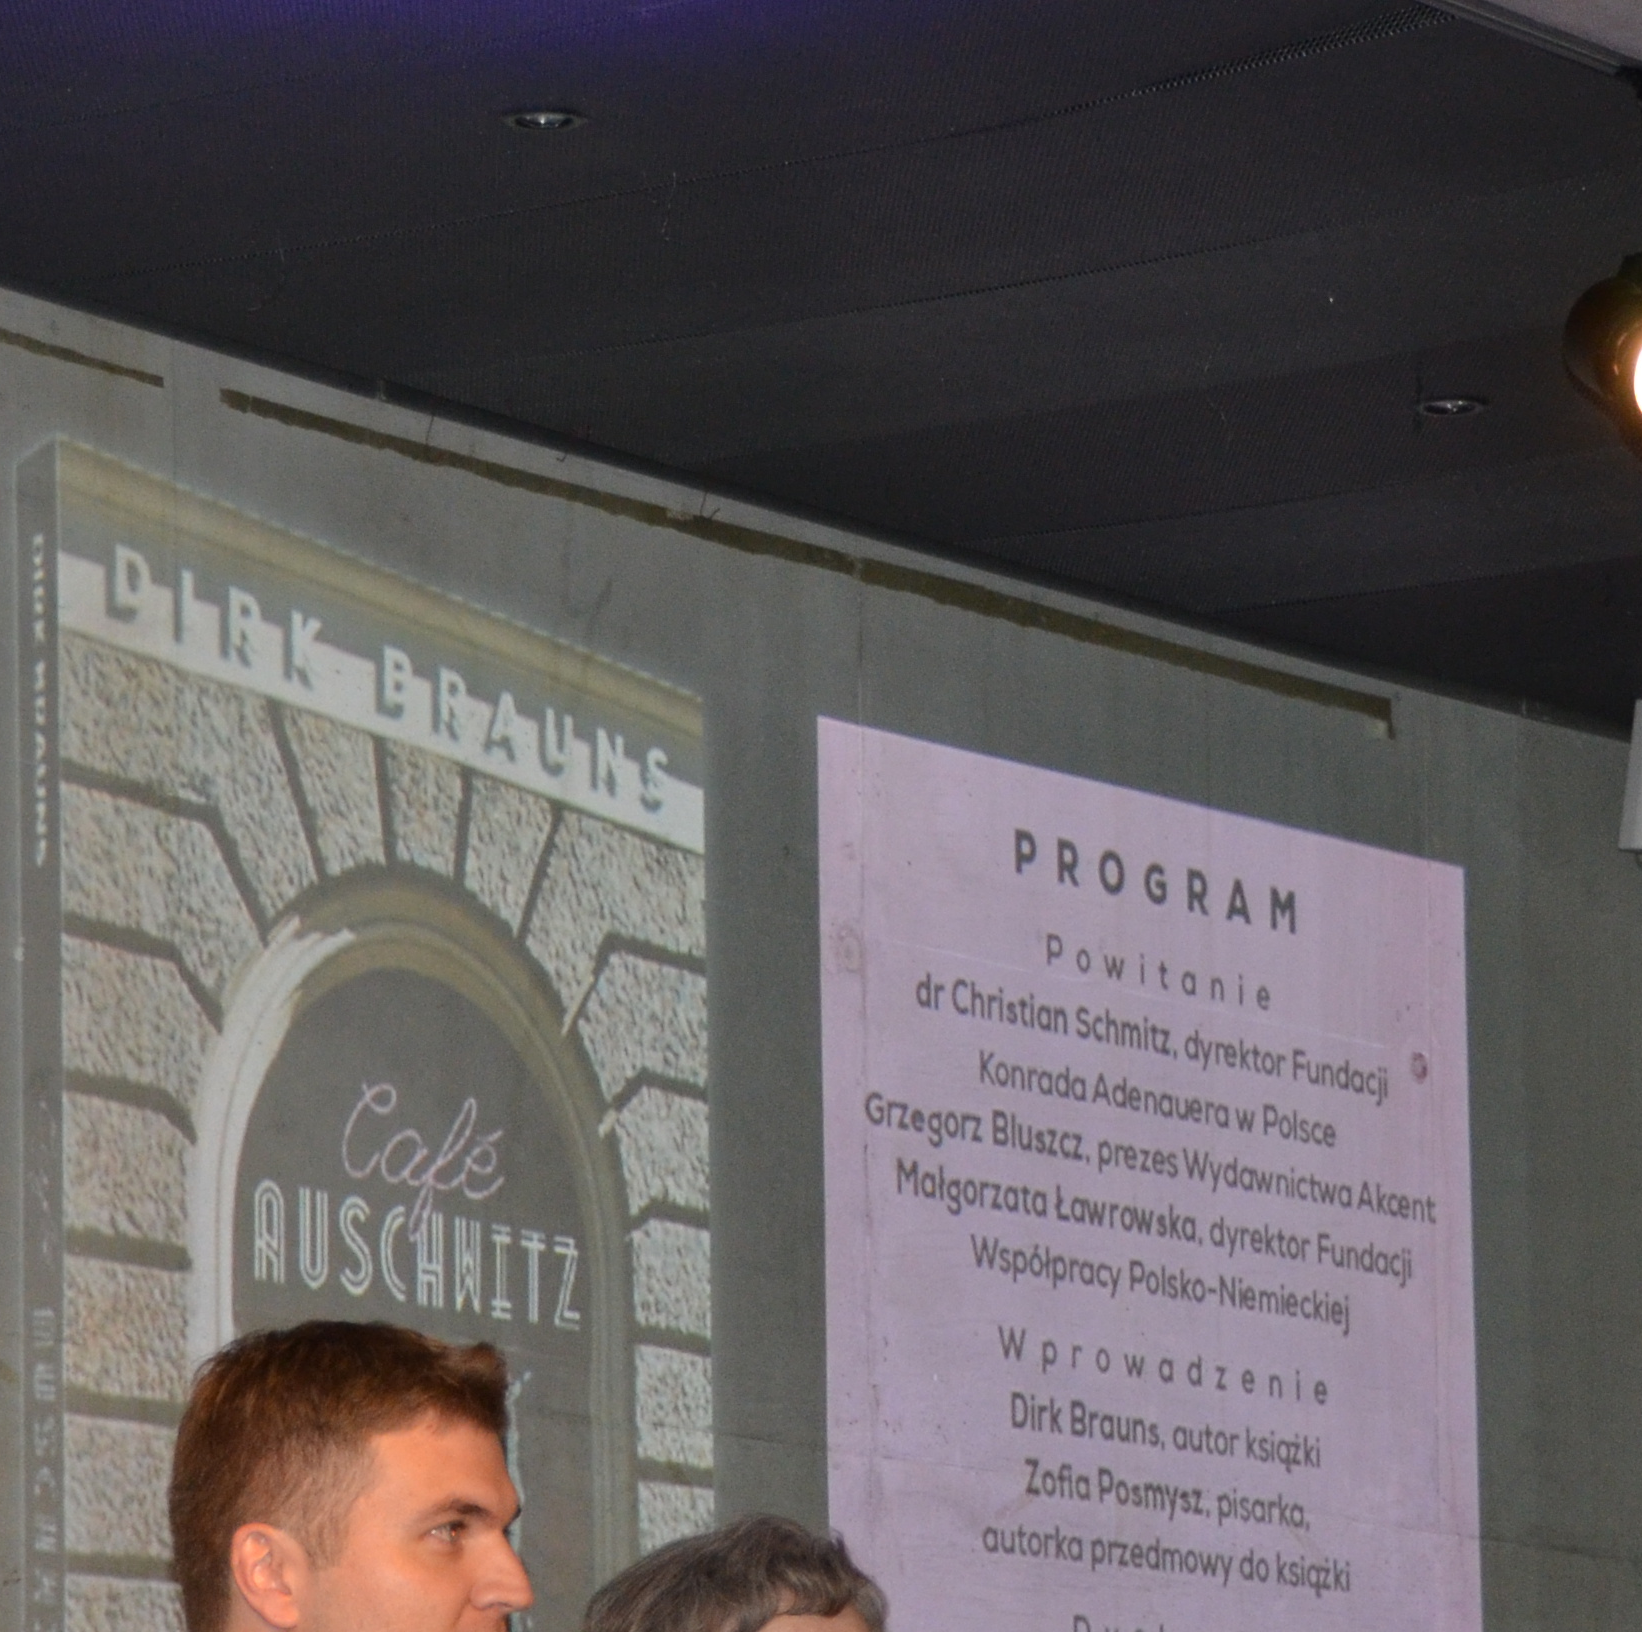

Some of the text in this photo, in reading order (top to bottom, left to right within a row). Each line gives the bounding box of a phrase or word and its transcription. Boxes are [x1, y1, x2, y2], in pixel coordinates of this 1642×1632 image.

[110, 543, 669, 810] DIRK BRAUNS
[1014, 829, 1297, 935] PROGRAM
[1046, 933, 1271, 1012] Powitanie
[915, 973, 1389, 1108] dr Christian Schmitz, dyrektor Fundacji
[979, 1050, 1338, 1149] Konrada Adenauera w Polsce
[342, 1083, 505, 1242] Café
[863, 1091, 1437, 1225] Grzegorz Bluszcz, prezes Wydawnictwa Akcent
[254, 1180, 582, 1331] AUSCHWITZ
[896, 1157, 1413, 1289] Małgorzata Ławrowska, dyrektor Fundacji
[970, 1234, 1351, 1337] Współpracy Polsko-Niemieckiej
[998, 1326, 1329, 1403] Wprowadzenie
[1010, 1391, 1322, 1475] Dirk Brauns, autor książki
[1024, 1457, 1310, 1531] Zofia Posmysz, pisarka,
[982, 1526, 1352, 1599] autorka przedmowy do książki
